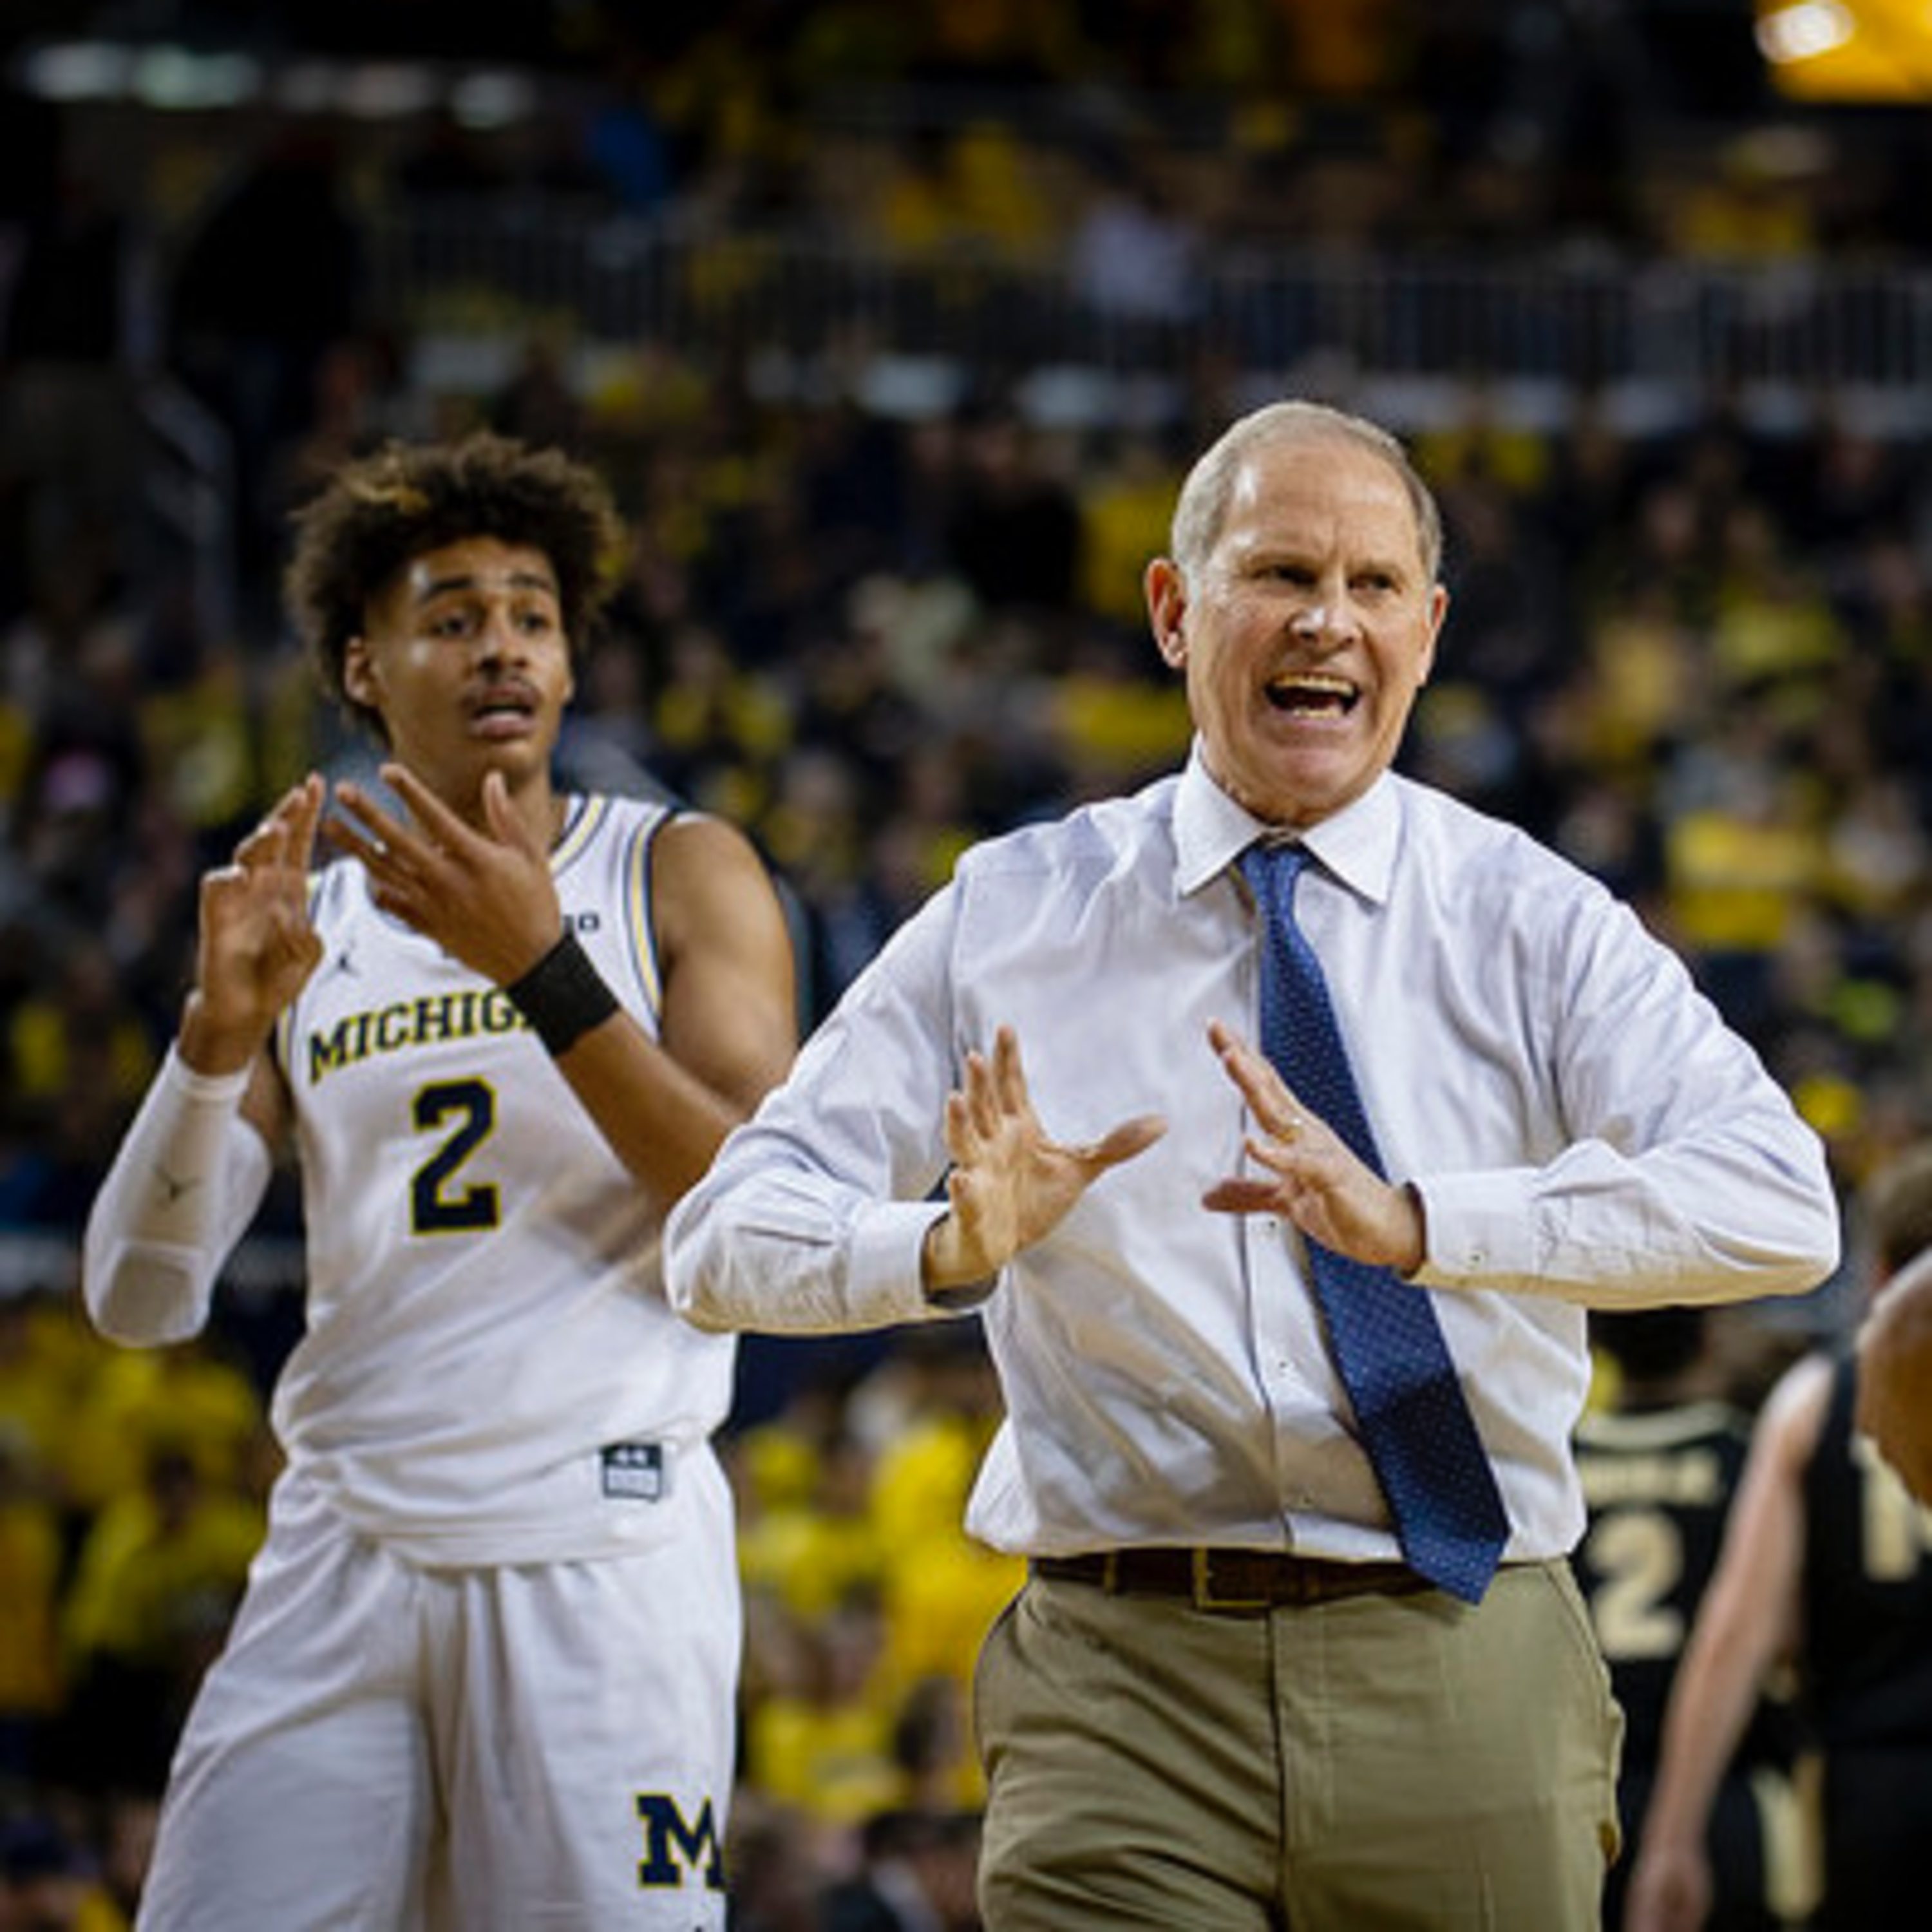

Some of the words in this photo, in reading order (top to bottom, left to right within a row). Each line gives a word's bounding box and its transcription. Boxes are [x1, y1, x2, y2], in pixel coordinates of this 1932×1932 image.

[310, 987, 535, 1085] MICHIG
[411, 1075, 500, 1236] 2
[1586, 1509, 1683, 1660] 2
[634, 1791, 726, 1892] M
